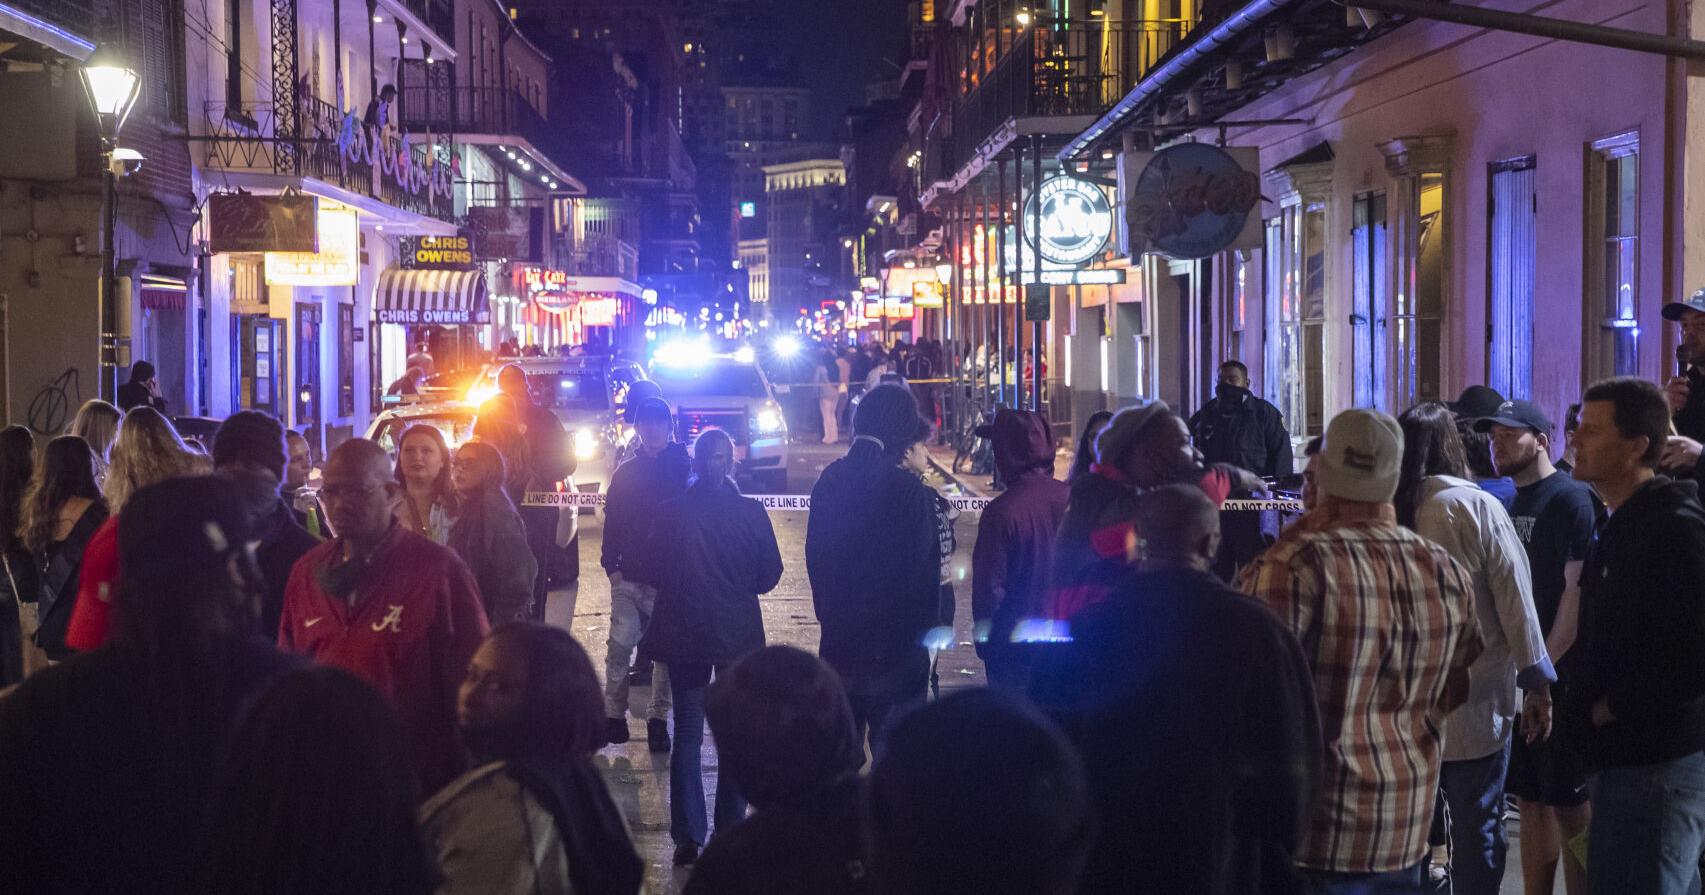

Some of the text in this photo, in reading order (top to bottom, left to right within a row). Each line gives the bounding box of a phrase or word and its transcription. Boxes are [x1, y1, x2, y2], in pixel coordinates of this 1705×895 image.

[421, 237, 468, 249] CHRIS
[416, 250, 471, 263] OWENS
[380, 311, 418, 322] CHRIS
[423, 311, 469, 322] OWENS
[527, 494, 546, 504] LINE
[548, 494, 560, 504] DO
[561, 494, 579, 505] NOT
[580, 495, 607, 506] CROSS
[777, 497, 798, 508] LINE
[1224, 502, 1300, 512] DO NOT CROSS
[372, 605, 403, 632] A
